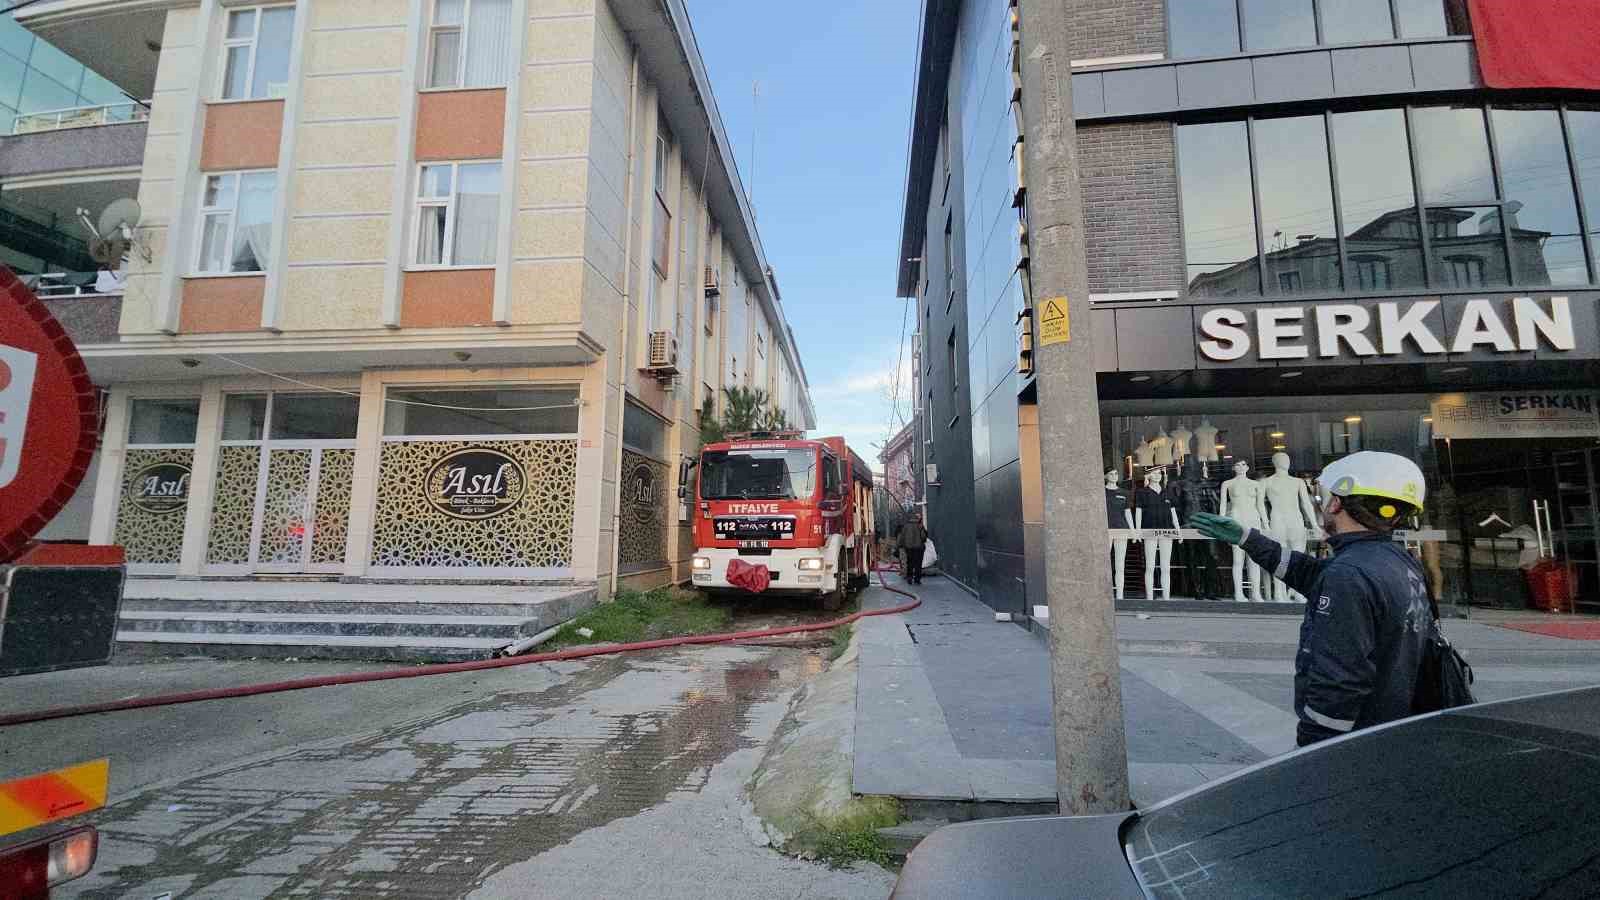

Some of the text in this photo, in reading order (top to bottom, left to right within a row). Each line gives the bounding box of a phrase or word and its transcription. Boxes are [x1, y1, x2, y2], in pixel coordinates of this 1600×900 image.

[1200, 297, 1576, 361] SERKAN
[1500, 394, 1593, 415] SERKAN
[716, 522, 736, 531] 112
[771, 521, 792, 531] 112
